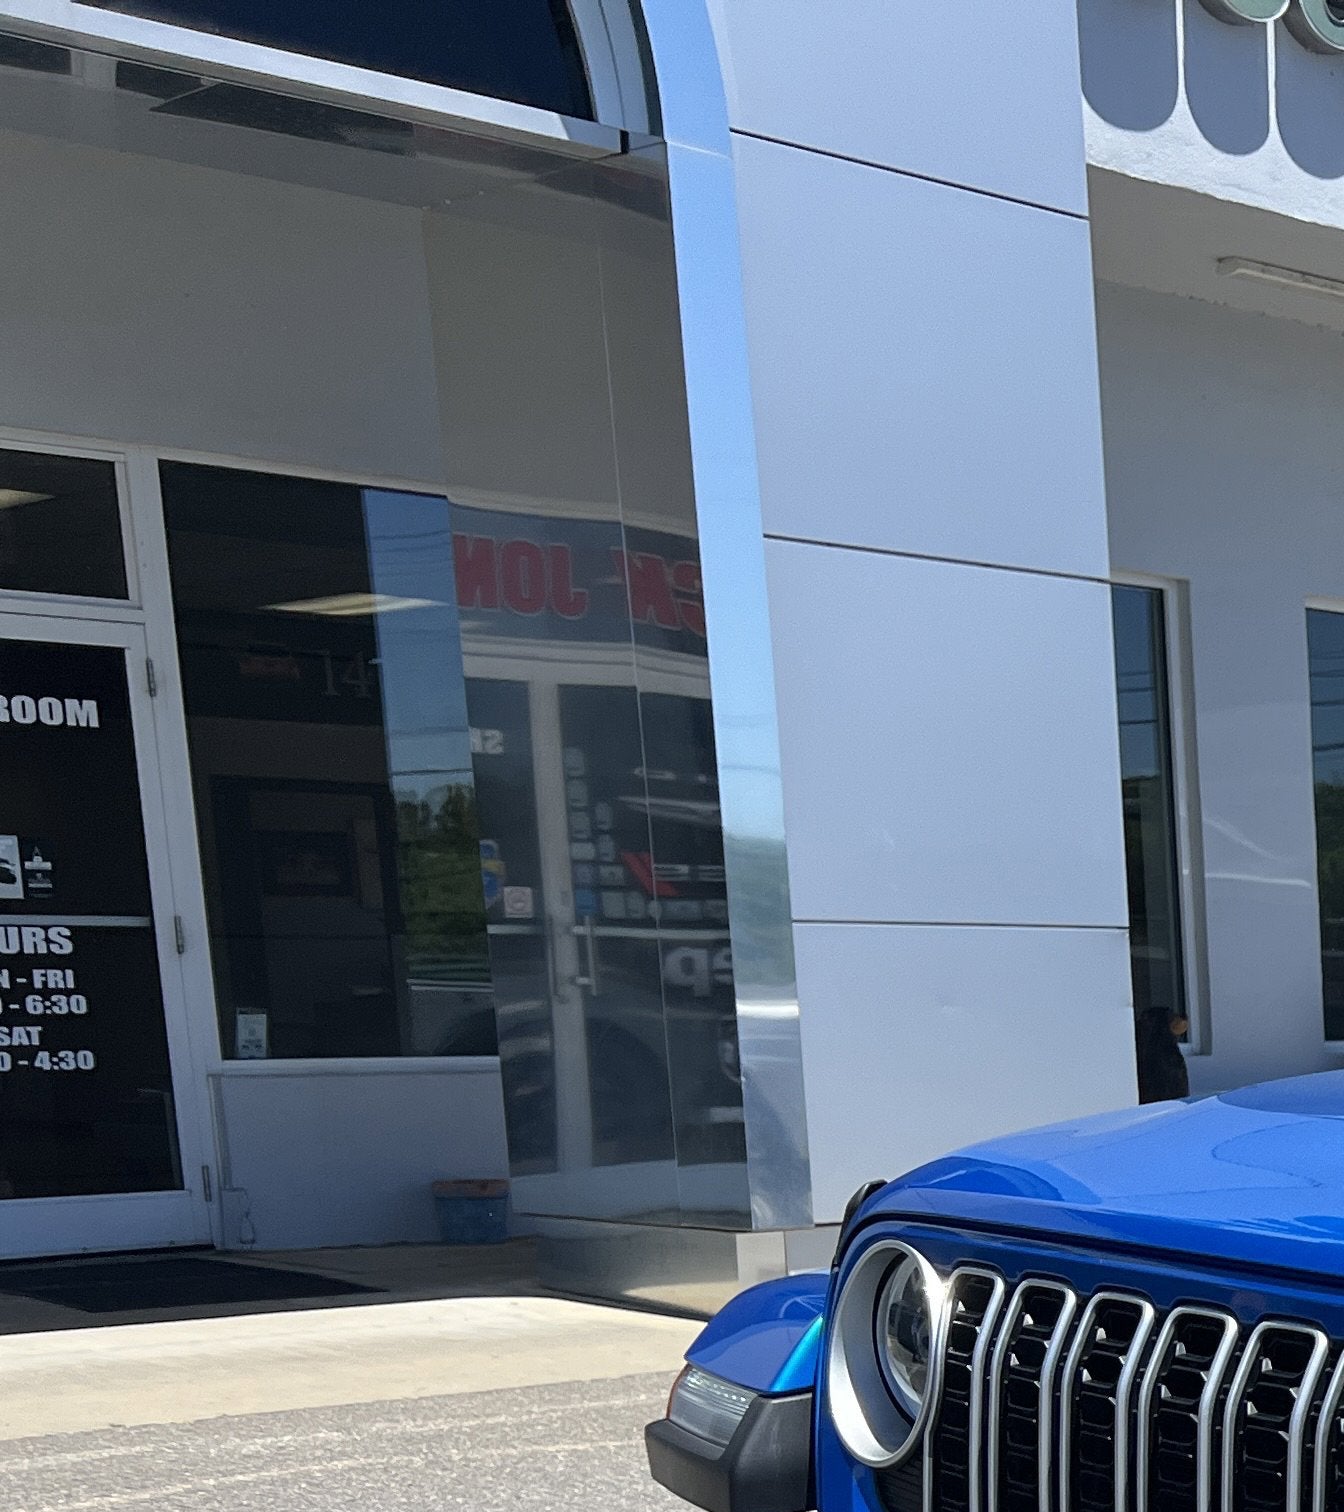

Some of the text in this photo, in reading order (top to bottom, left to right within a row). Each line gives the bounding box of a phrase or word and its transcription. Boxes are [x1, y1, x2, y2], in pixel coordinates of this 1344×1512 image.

[32, 968, 75, 989] FRI
[25, 994, 88, 1015] 6:30
[34, 1049, 95, 1071] 4:30
